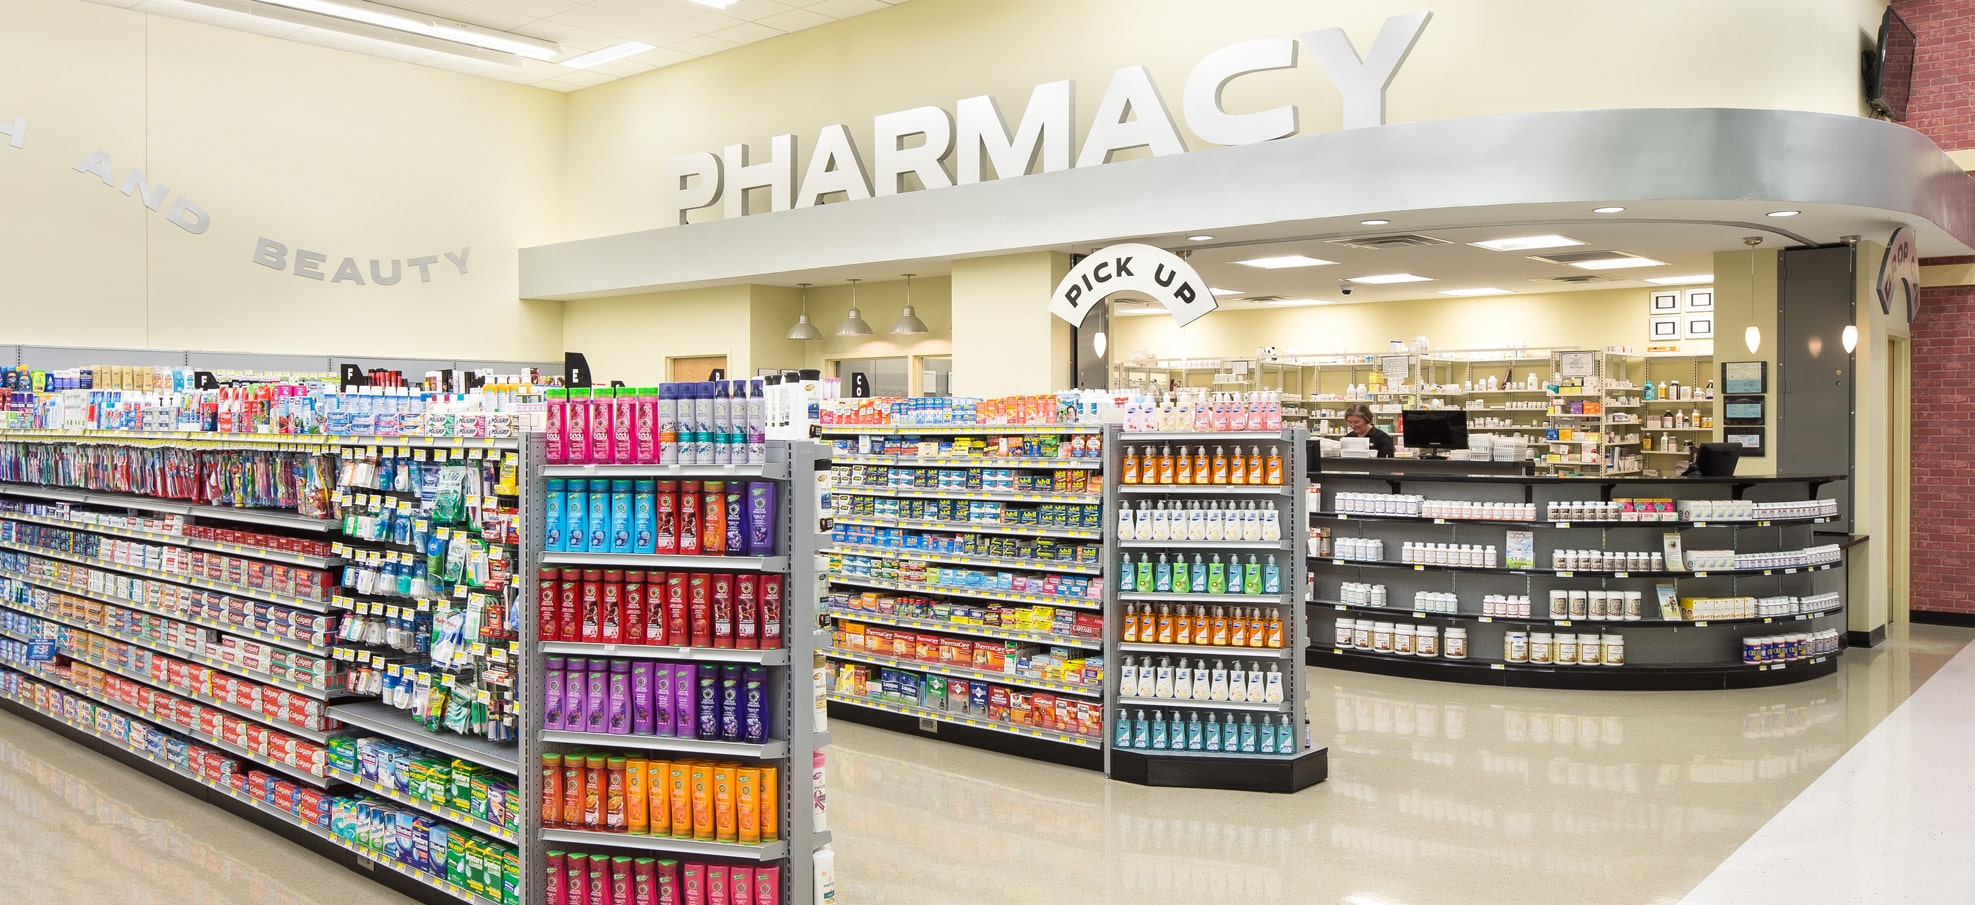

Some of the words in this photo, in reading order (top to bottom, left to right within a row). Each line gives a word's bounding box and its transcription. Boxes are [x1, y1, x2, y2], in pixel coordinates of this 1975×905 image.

[664, 10, 1434, 226] PHARMACY
[72, 150, 210, 235] AND
[253, 236, 471, 286] BEAUTY
[1064, 256, 1134, 308] PICK
[1154, 262, 1196, 304] UP
[348, 368, 354, 380] F
[572, 368, 579, 383] E
[201, 376, 207, 386] F
[296, 616, 313, 626] Colgate
[296, 630, 312, 640] Colgate
[866, 628, 893, 638] ThermaCare
[917, 636, 939, 644] ThermaCare
[940, 638, 970, 648] ThermaCare
[975, 642, 1005, 652] ThermaCare
[296, 657, 313, 667] Colgate
[212, 676, 227, 685] Colgate
[296, 672, 312, 682] Colgate
[214, 688, 227, 697] Colgate
[237, 684, 252, 693] Colgate
[264, 688, 279, 699] Colgate
[237, 696, 252, 706] Colgate
[290, 696, 306, 708] Colgate
[264, 702, 279, 713] Colgate
[290, 711, 306, 722] Colgate
[270, 736, 286, 746] Colgate
[270, 748, 286, 758] Colgate
[296, 746, 313, 756] Colgate
[206, 757, 220, 767] Colgate
[296, 758, 312, 769] Colgate
[206, 769, 222, 779] Colgate
[249, 774, 265, 784] Colgate
[250, 786, 265, 796] Colgate
[275, 784, 291, 796] Colgate
[276, 796, 291, 808] Colgate
[302, 792, 318, 804] Colgate
[302, 806, 318, 818] Colgate
